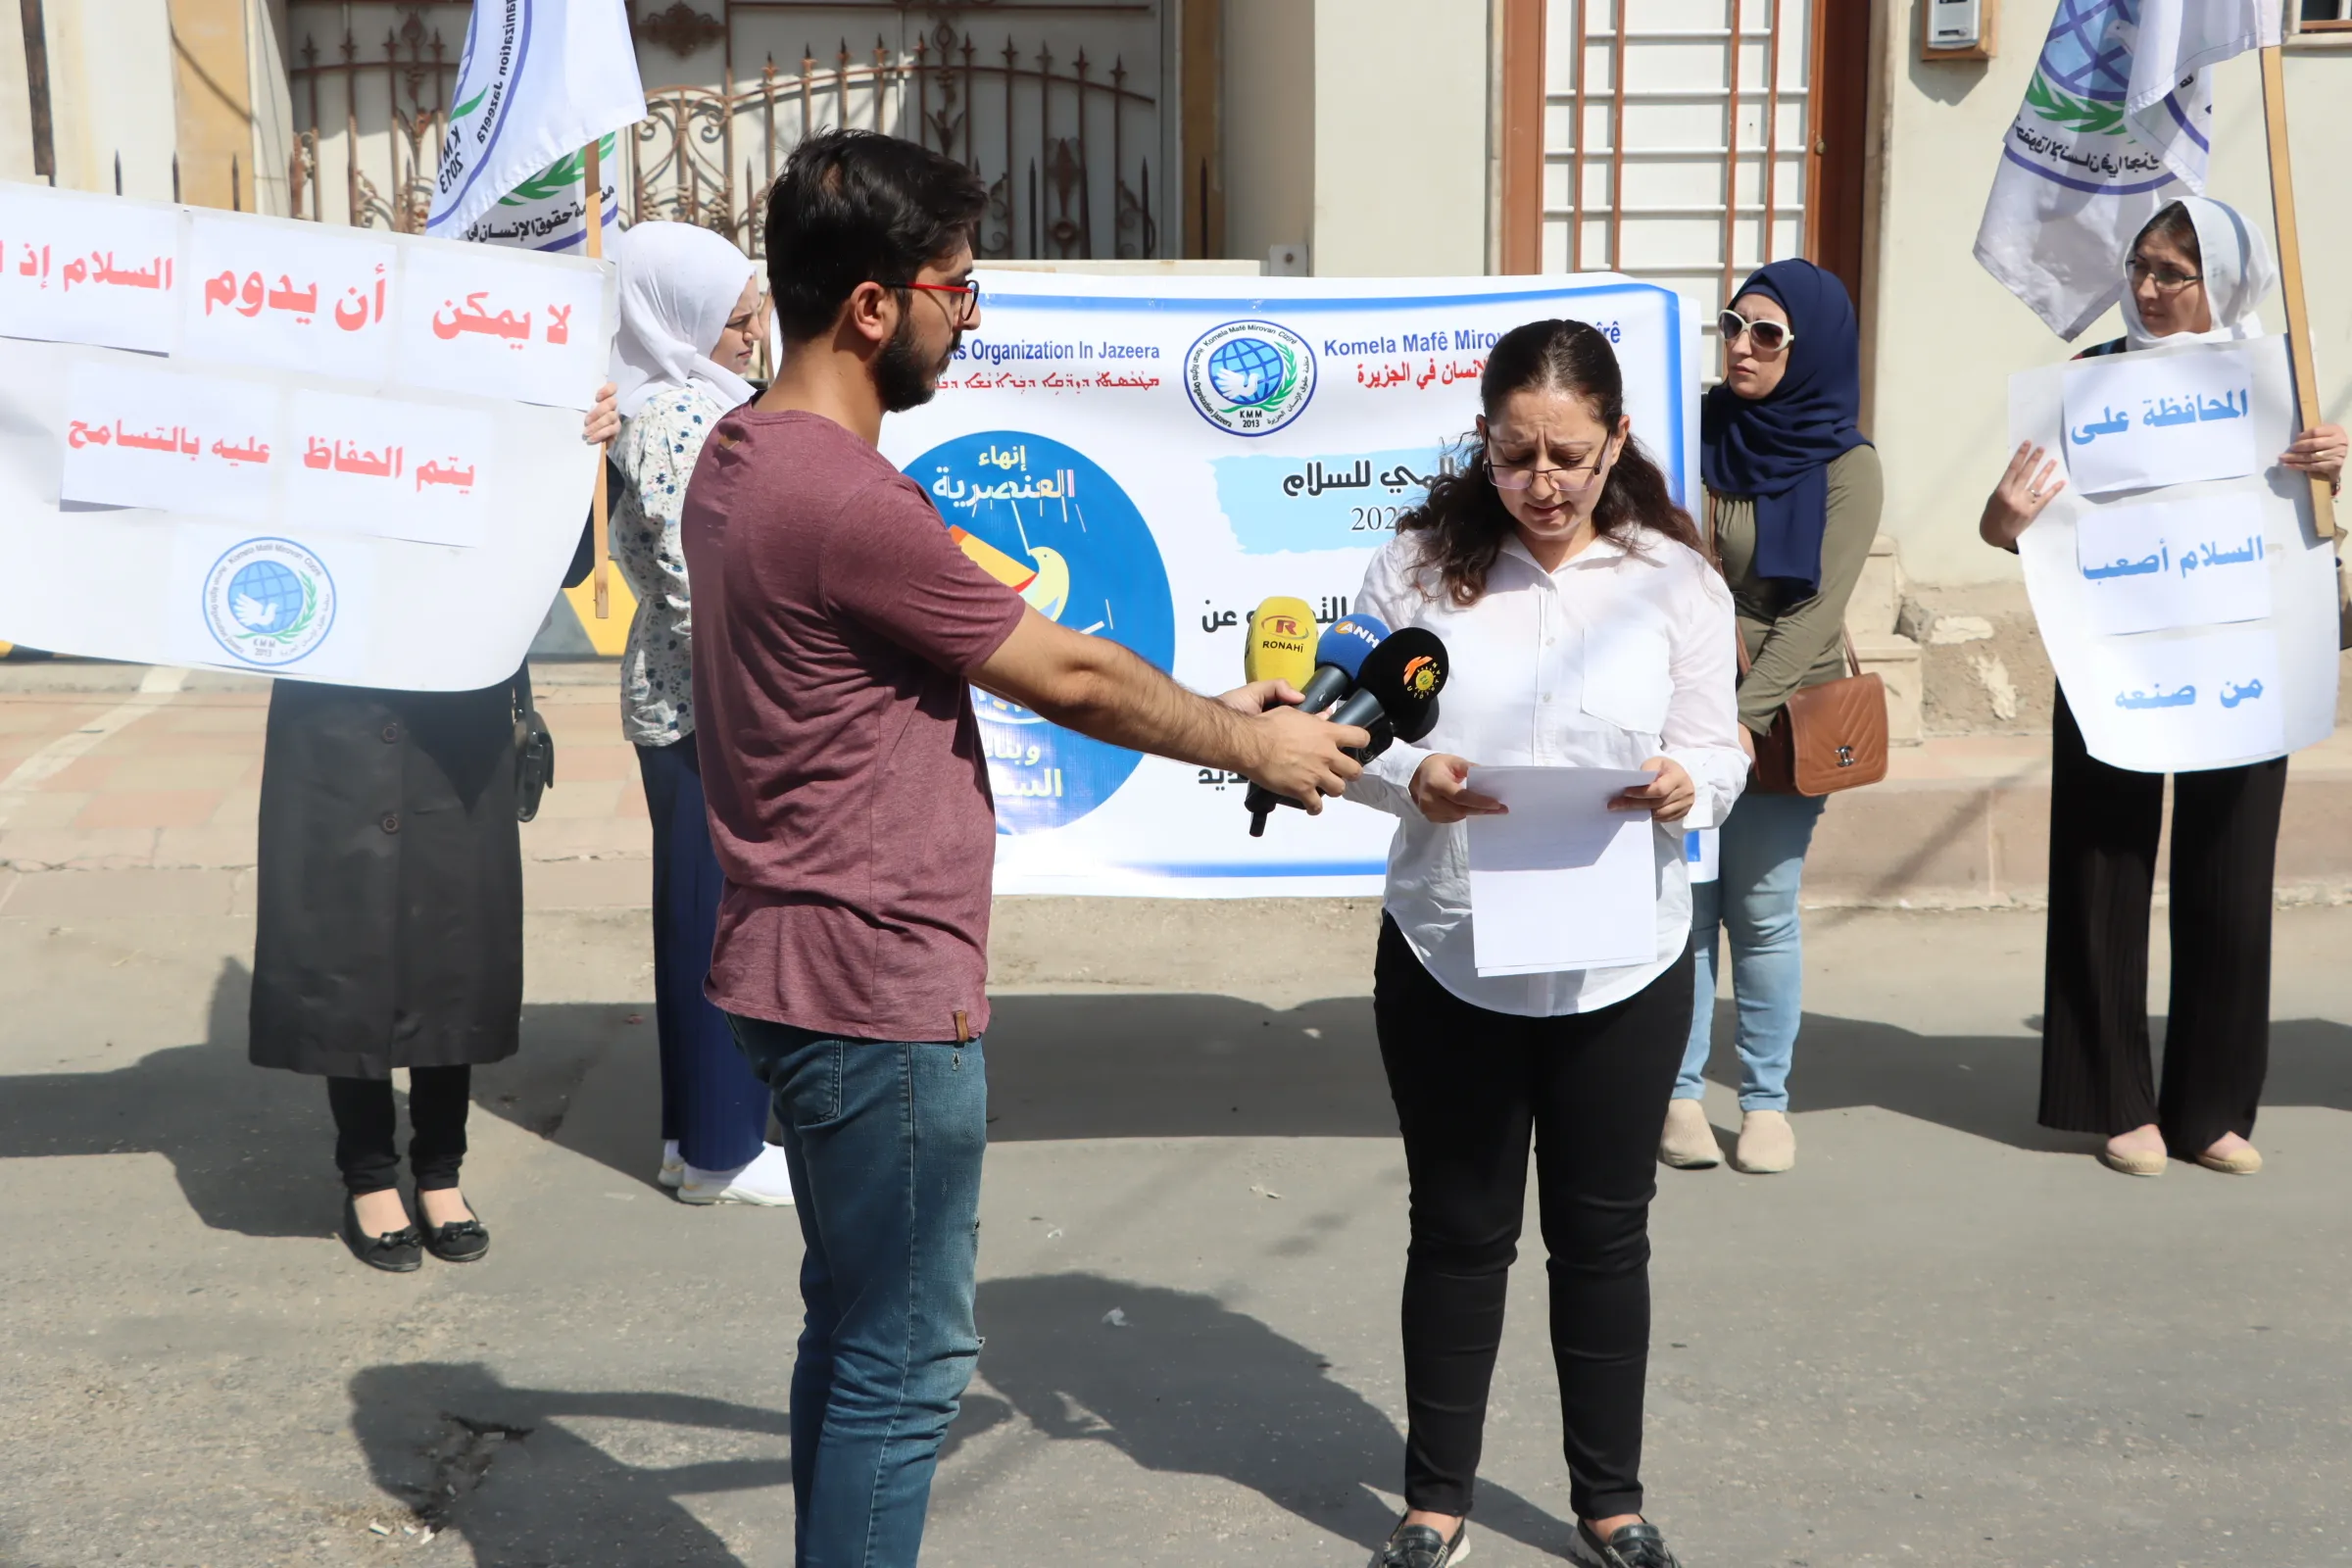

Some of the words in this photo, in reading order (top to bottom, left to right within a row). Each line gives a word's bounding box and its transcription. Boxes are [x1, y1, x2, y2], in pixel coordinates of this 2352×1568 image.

[479, 219, 536, 243] الإنسان
[535, 209, 572, 236] حقوق
[64, 251, 172, 292] السلام
[205, 270, 318, 323] يدوم
[334, 264, 385, 331] أن
[433, 291, 531, 350] يمكن
[547, 304, 571, 345] لا
[1248, 324, 1276, 334] Mirovan
[971, 339, 1074, 366] Organization
[1079, 341, 1094, 359] In
[1099, 341, 1160, 360] Jazeera
[1324, 337, 1396, 357] Komela
[1403, 331, 1448, 352] Mafê
[1454, 329, 1502, 350] Miro
[1357, 362, 1410, 389] الجزيرة
[1416, 358, 1438, 390] في
[1243, 419, 1260, 428] 2013
[2142, 388, 2248, 428] المحافظة
[68, 419, 200, 461] بالتسامح
[2071, 406, 2131, 446] على
[212, 437, 270, 466] عليه
[303, 436, 403, 478] الحفاظ
[979, 445, 1027, 471] إنهاء
[416, 455, 475, 494] يتم
[933, 466, 1075, 508] العنصرية
[1283, 460, 1371, 497] للسلام
[2082, 538, 2170, 585] أصعب
[2179, 535, 2264, 578] السلام
[1202, 600, 1238, 633] عن
[1276, 619, 1297, 635] R
[1340, 622, 1380, 649] ANH
[2115, 680, 2196, 710] صنعه
[2219, 677, 2264, 708] من
